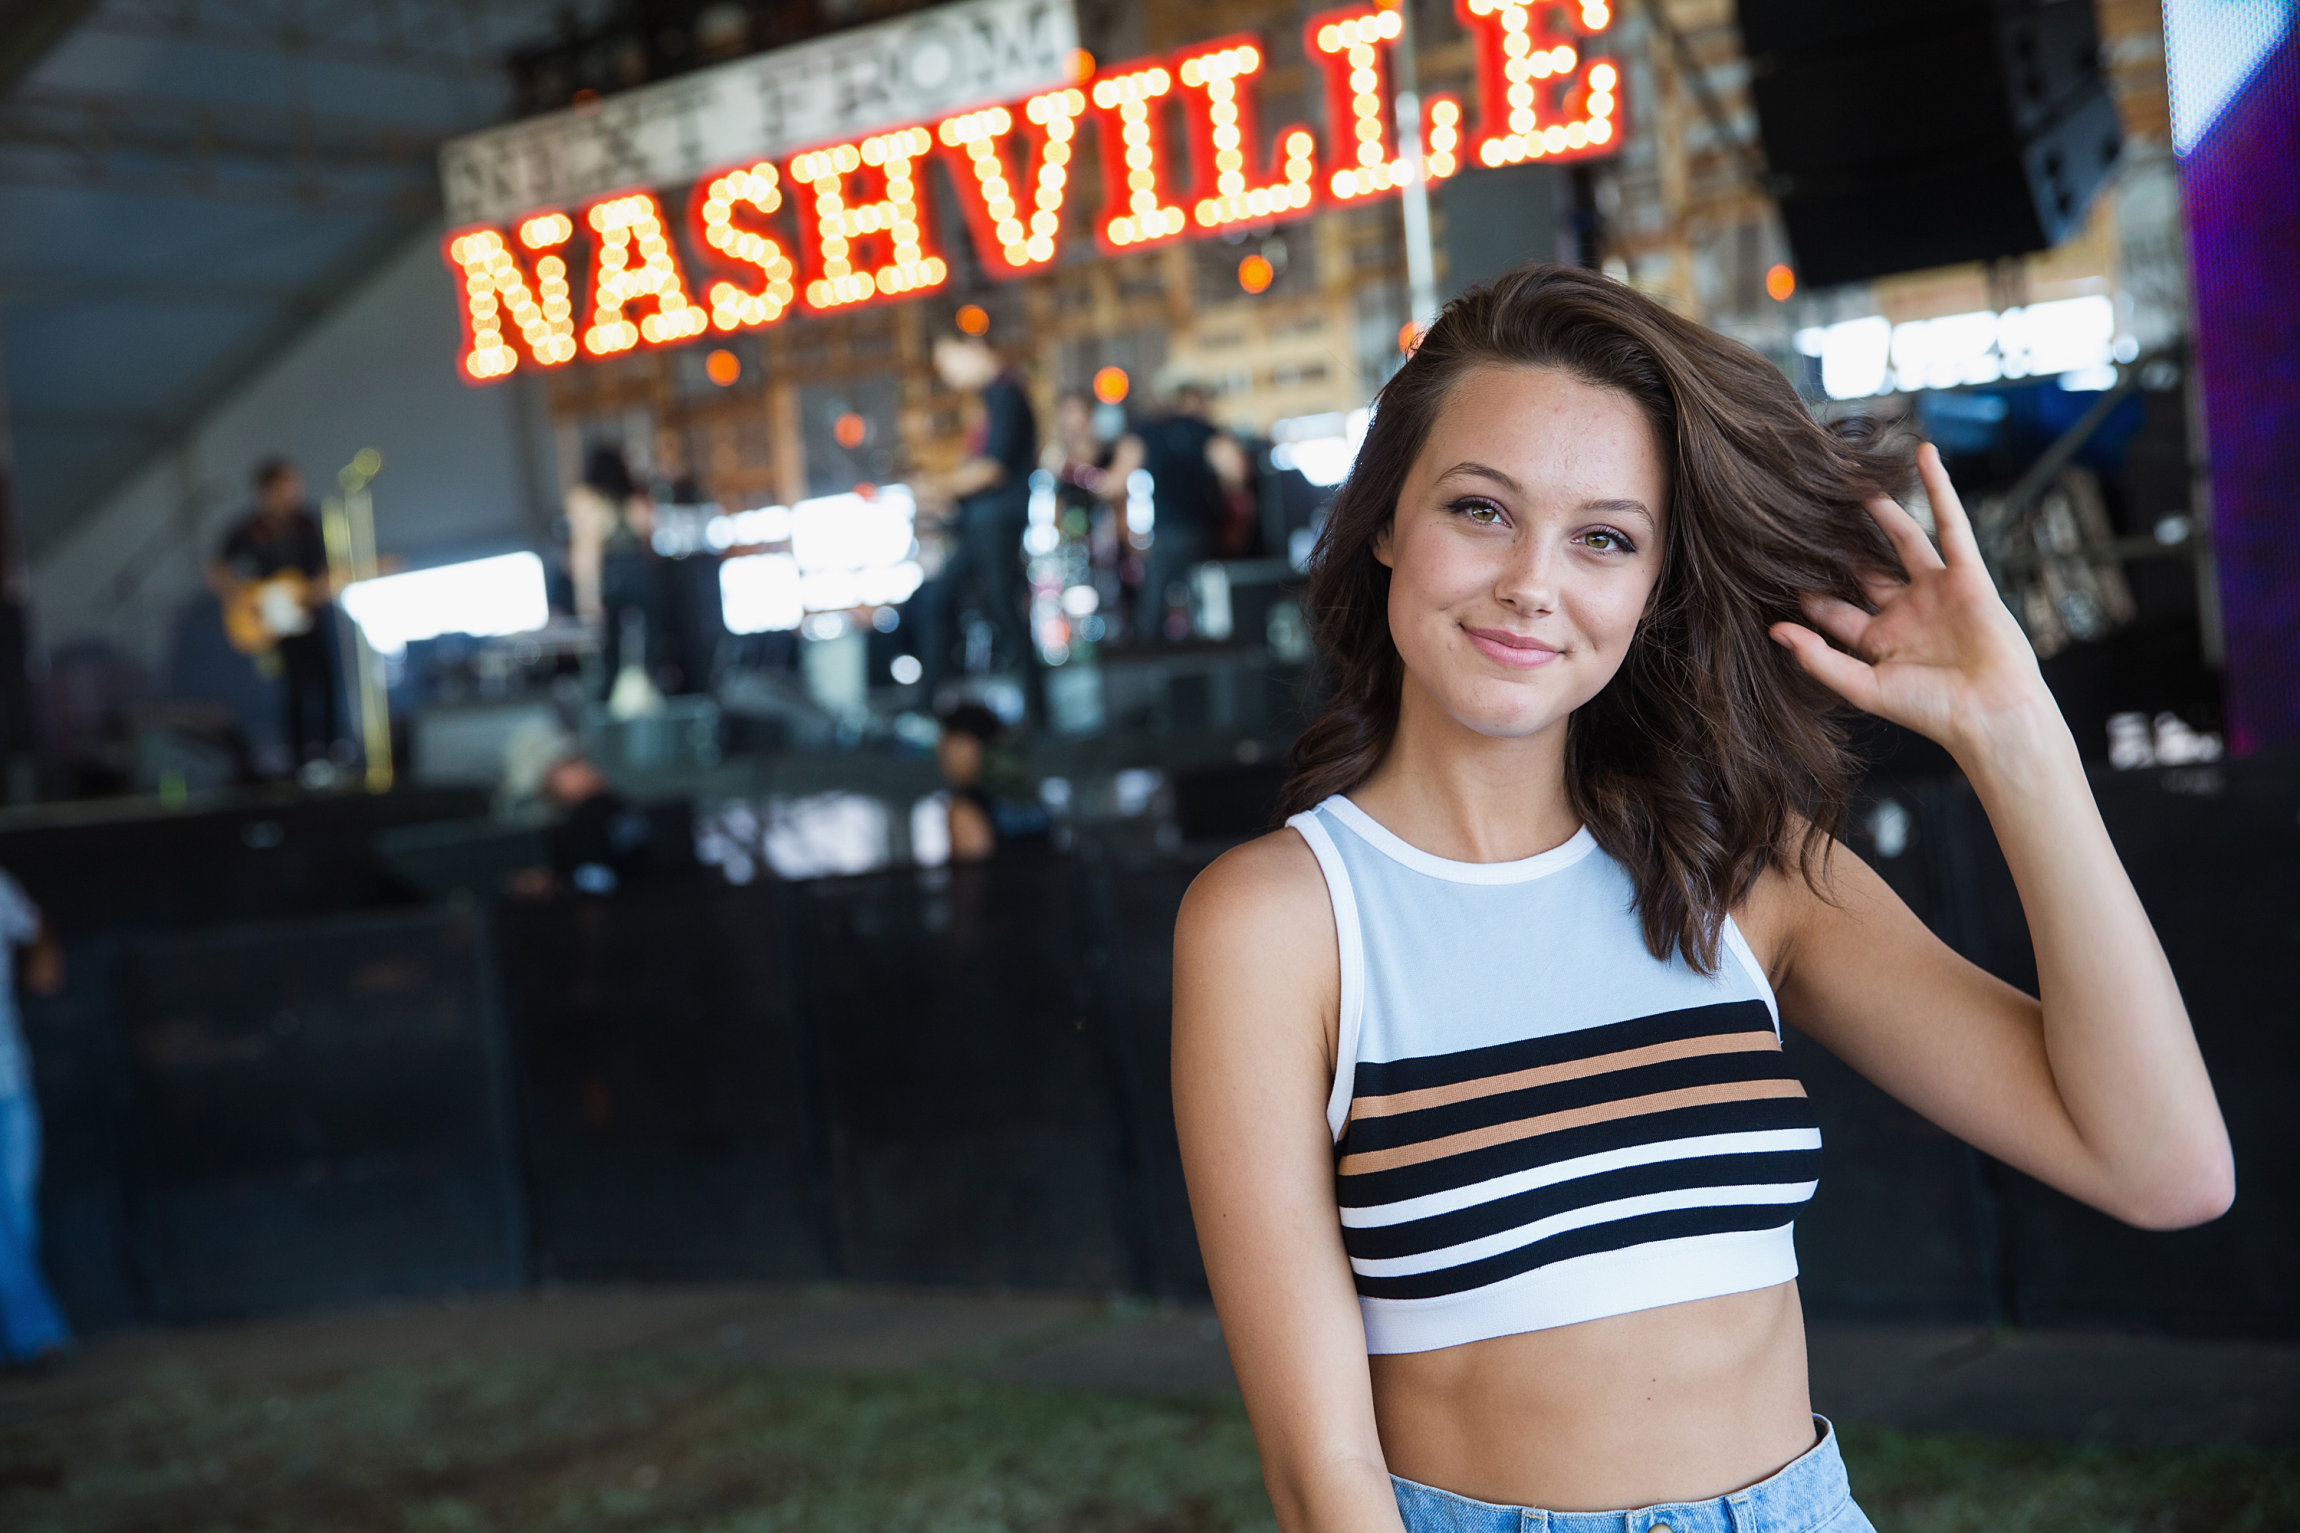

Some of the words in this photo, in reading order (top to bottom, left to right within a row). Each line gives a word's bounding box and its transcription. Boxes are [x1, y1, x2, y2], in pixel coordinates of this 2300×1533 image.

[444, 88, 724, 222] NEXT
[758, 0, 1069, 150] FROM
[444, 0, 1622, 384] NASHVILLE
